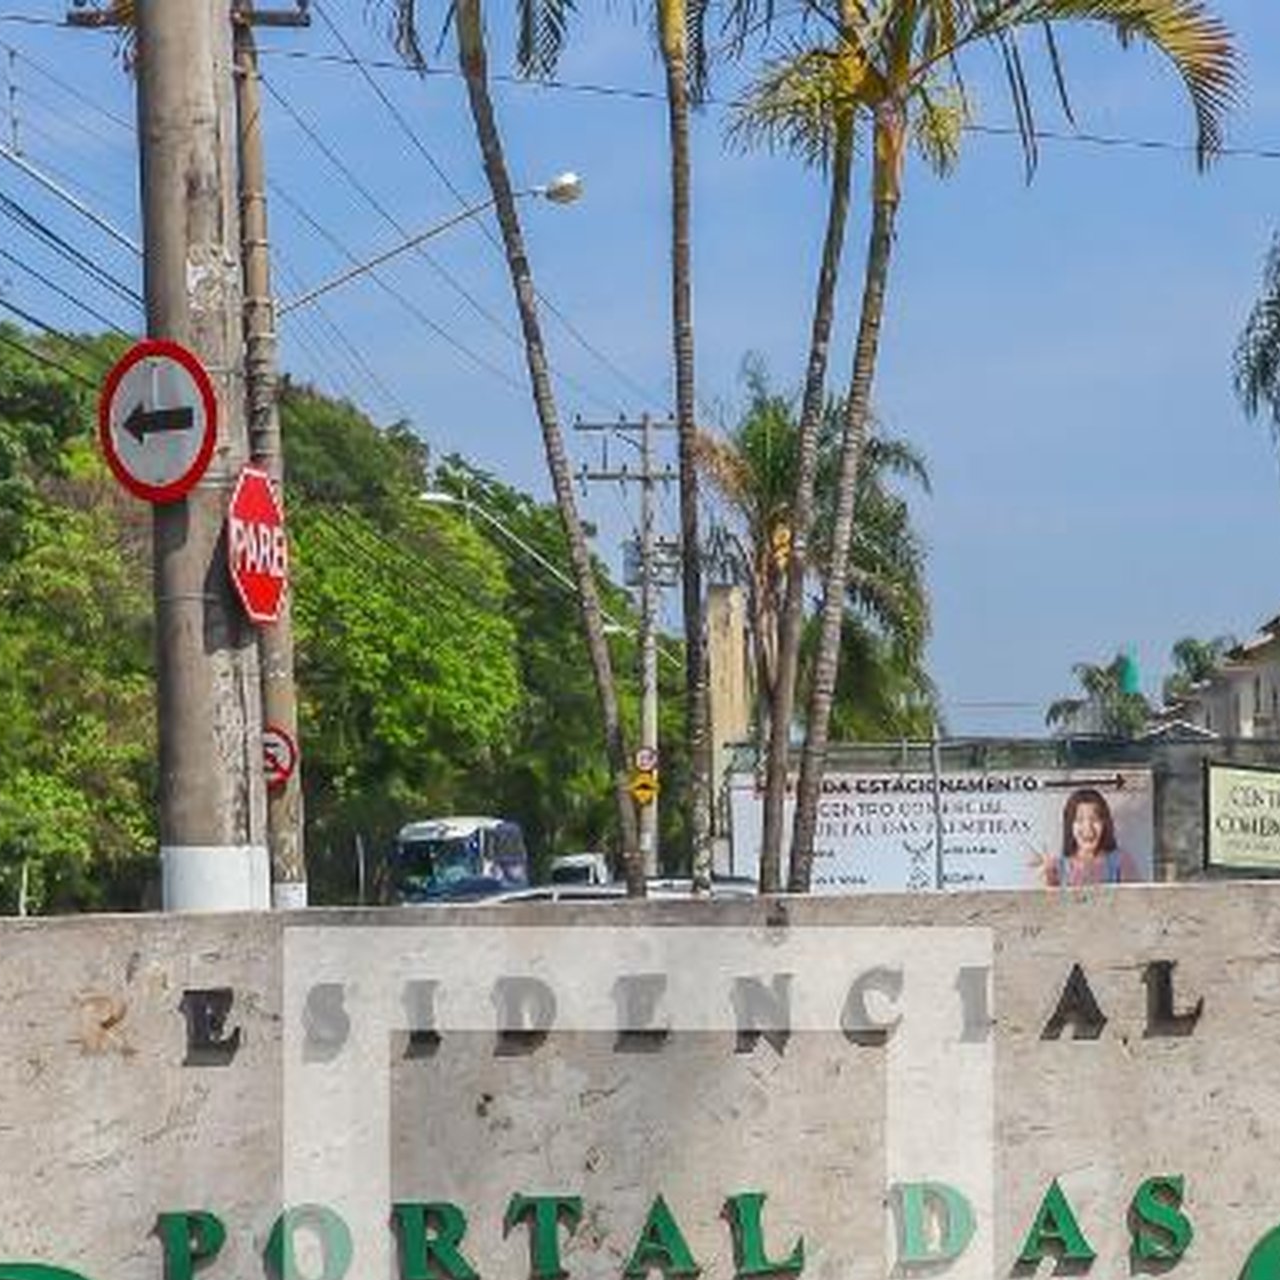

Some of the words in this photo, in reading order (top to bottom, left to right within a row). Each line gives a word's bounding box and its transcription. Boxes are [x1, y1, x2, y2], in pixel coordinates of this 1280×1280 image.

[230, 518, 288, 578] PARE
[856, 777, 1038, 795] ESTACIONAMENTO
[890, 1174, 1195, 1270] DAS
